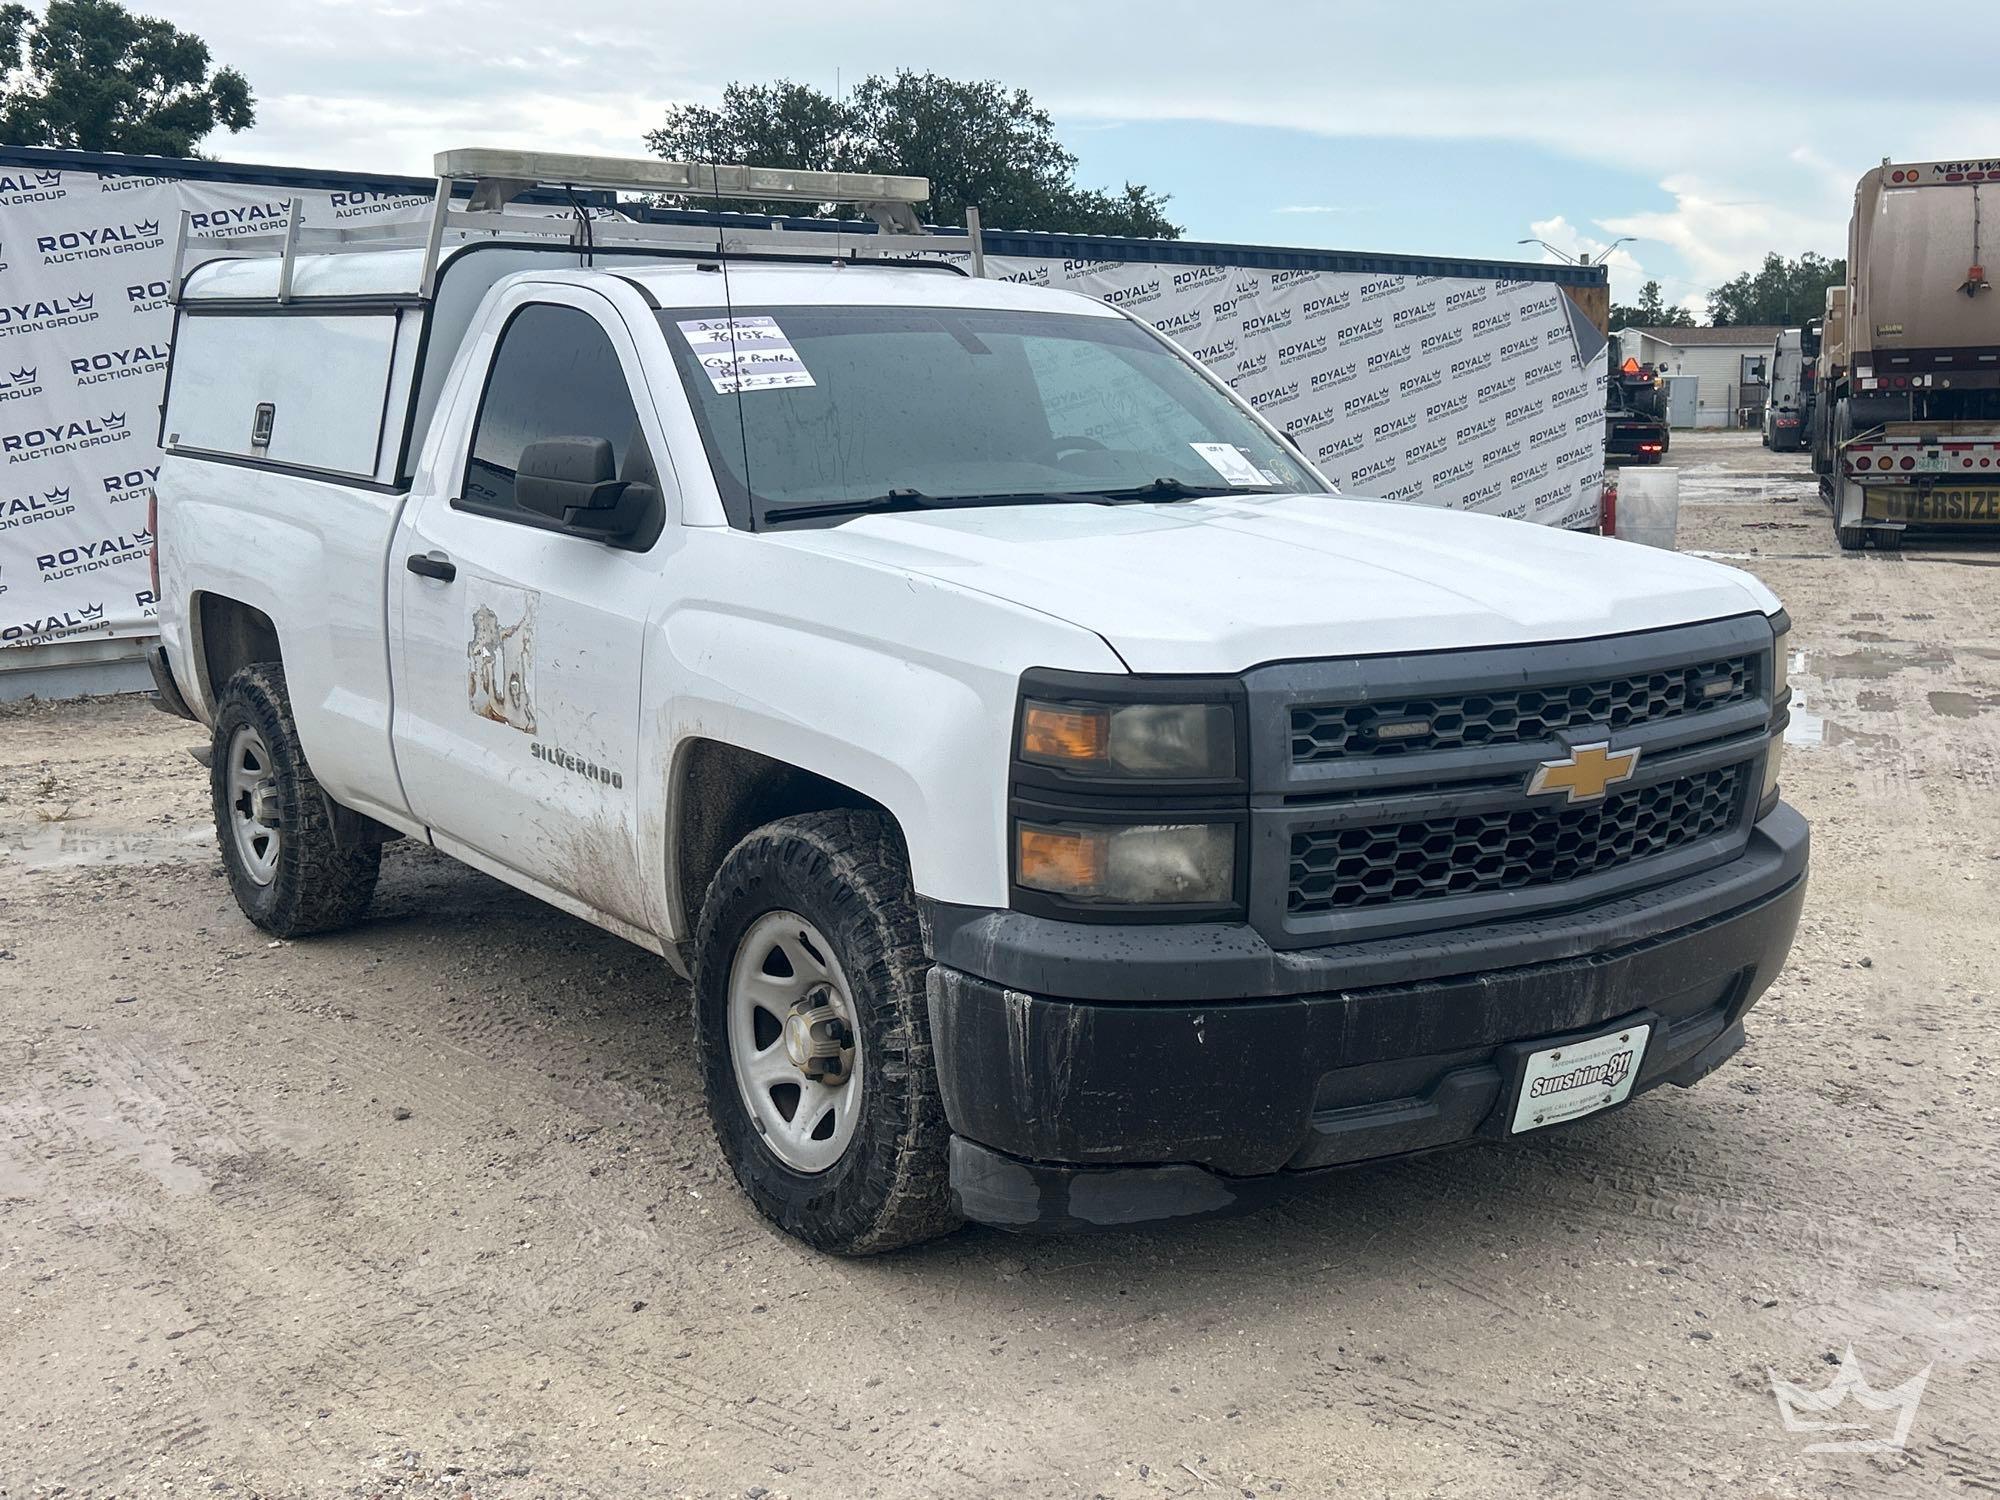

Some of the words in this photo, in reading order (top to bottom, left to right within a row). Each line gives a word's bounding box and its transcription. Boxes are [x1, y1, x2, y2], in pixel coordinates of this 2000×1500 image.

[1932, 162, 1974, 174] NEW
[10, 190, 66, 204] GROUP
[191, 204, 280, 229] ROYAL
[336, 203, 391, 218] AUCTION
[37, 225, 136, 252] ROYAL
[44, 246, 110, 265] AUCTION
[114, 239, 164, 253] GROUP
[1066, 269, 1097, 280] AUCTION
[1173, 267, 1215, 286] ROYAL
[1176, 282, 1204, 293] AUCTION
[1205, 274, 1227, 285] GROUP
[1103, 285, 1148, 303] ROYAL
[1272, 280, 1300, 291] AUCTION
[1361, 278, 1396, 295] ROYAL
[1362, 292, 1386, 302] AUCTION
[1386, 286, 1406, 295] GROUP
[1138, 293, 1161, 304] GROUP
[1239, 291, 1260, 301] GROUP
[1303, 295, 1340, 313] ROYAL
[1446, 289, 1478, 305] ROYAL
[1305, 310, 1330, 320] AUCTION
[1331, 302, 1350, 312] GROUP
[1393, 305, 1427, 322] ROYAL
[1520, 300, 1550, 316] ROYAL
[46, 312, 99, 329] GROUP
[1180, 322, 1201, 333] GROUP
[1242, 312, 1281, 331] ROYAL
[1244, 327, 1270, 338] AUCTION
[1271, 320, 1292, 330] GROUP
[1395, 318, 1418, 328] AUCTION
[1472, 315, 1503, 332] ROYAL
[1337, 321, 1373, 339] ROYAL
[1340, 336, 1364, 346] AUCTION
[1364, 329, 1383, 338] GROUP
[1421, 331, 1454, 349] ROYAL
[1501, 339, 1530, 356] ROYAL
[1214, 351, 1235, 361] GROUP
[1278, 340, 1317, 359] ROYAL
[1280, 354, 1306, 365] AUCTION
[1308, 347, 1327, 357] GROUP
[1367, 349, 1401, 367] ROYAL
[71, 344, 167, 374] ROYAL
[1369, 364, 1393, 373] AUCTION
[1394, 355, 1411, 365] GROUP
[1451, 356, 1483, 373] ROYAL
[77, 367, 143, 386] AUCTION
[1247, 366, 1268, 377] GROUP
[1311, 367, 1347, 386] ROYAL
[1525, 363, 1555, 380] ROYAL
[1312, 381, 1337, 392] AUCTION
[1338, 374, 1357, 384] GROUP
[1400, 374, 1432, 392] ROYAL
[1478, 381, 1508, 398] ROYAL
[1250, 386, 1289, 406] ROYAL
[1279, 394, 1300, 404] GROUP
[1345, 392, 1380, 411] ROYAL
[1552, 386, 1581, 402] ROYAL
[1346, 407, 1370, 417] AUCTION
[1371, 399, 1390, 409] GROUP
[1426, 399, 1459, 417] ROYAL
[1505, 404, 1535, 420] ROYAL
[1575, 408, 1603, 425] ROYAL
[1286, 412, 1324, 431] ROYAL
[1315, 418, 1334, 428] GROUP
[1374, 417, 1408, 436] ROYAL
[1457, 422, 1488, 439] ROYAL
[2, 419, 102, 452] ROYAL
[1375, 433, 1399, 443] AUCTION
[1399, 424, 1417, 434] GROUP
[1530, 426, 1559, 443] ROYAL
[9, 445, 77, 464] AUCTION
[80, 430, 131, 448] GROUP
[1319, 438, 1354, 457] ROYAL
[1321, 454, 1344, 464] AUCTION
[1345, 444, 1364, 455] GROUP
[1406, 441, 1438, 459] ROYAL
[1483, 445, 1513, 462] ROYAL
[1556, 448, 1585, 464] ROYAL
[1351, 461, 1386, 480] ROYAL
[1353, 476, 1376, 487] AUCTION
[1377, 467, 1396, 477] GROUP
[1433, 464, 1465, 483] ROYAL
[1511, 467, 1540, 484] ROYAL
[1463, 486, 1493, 504] ROYAL
[1535, 488, 1564, 506] ROYAL
[1887, 491, 2000, 520] OVERSIZE
[23, 505, 76, 525] GROUP
[1562, 508, 1590, 525] ROYAL
[37, 537, 135, 571] ROYAL
[43, 559, 109, 582] AUCTION
[56, 621, 110, 638] GROUP
[531, 742, 623, 788] SILVERADO
